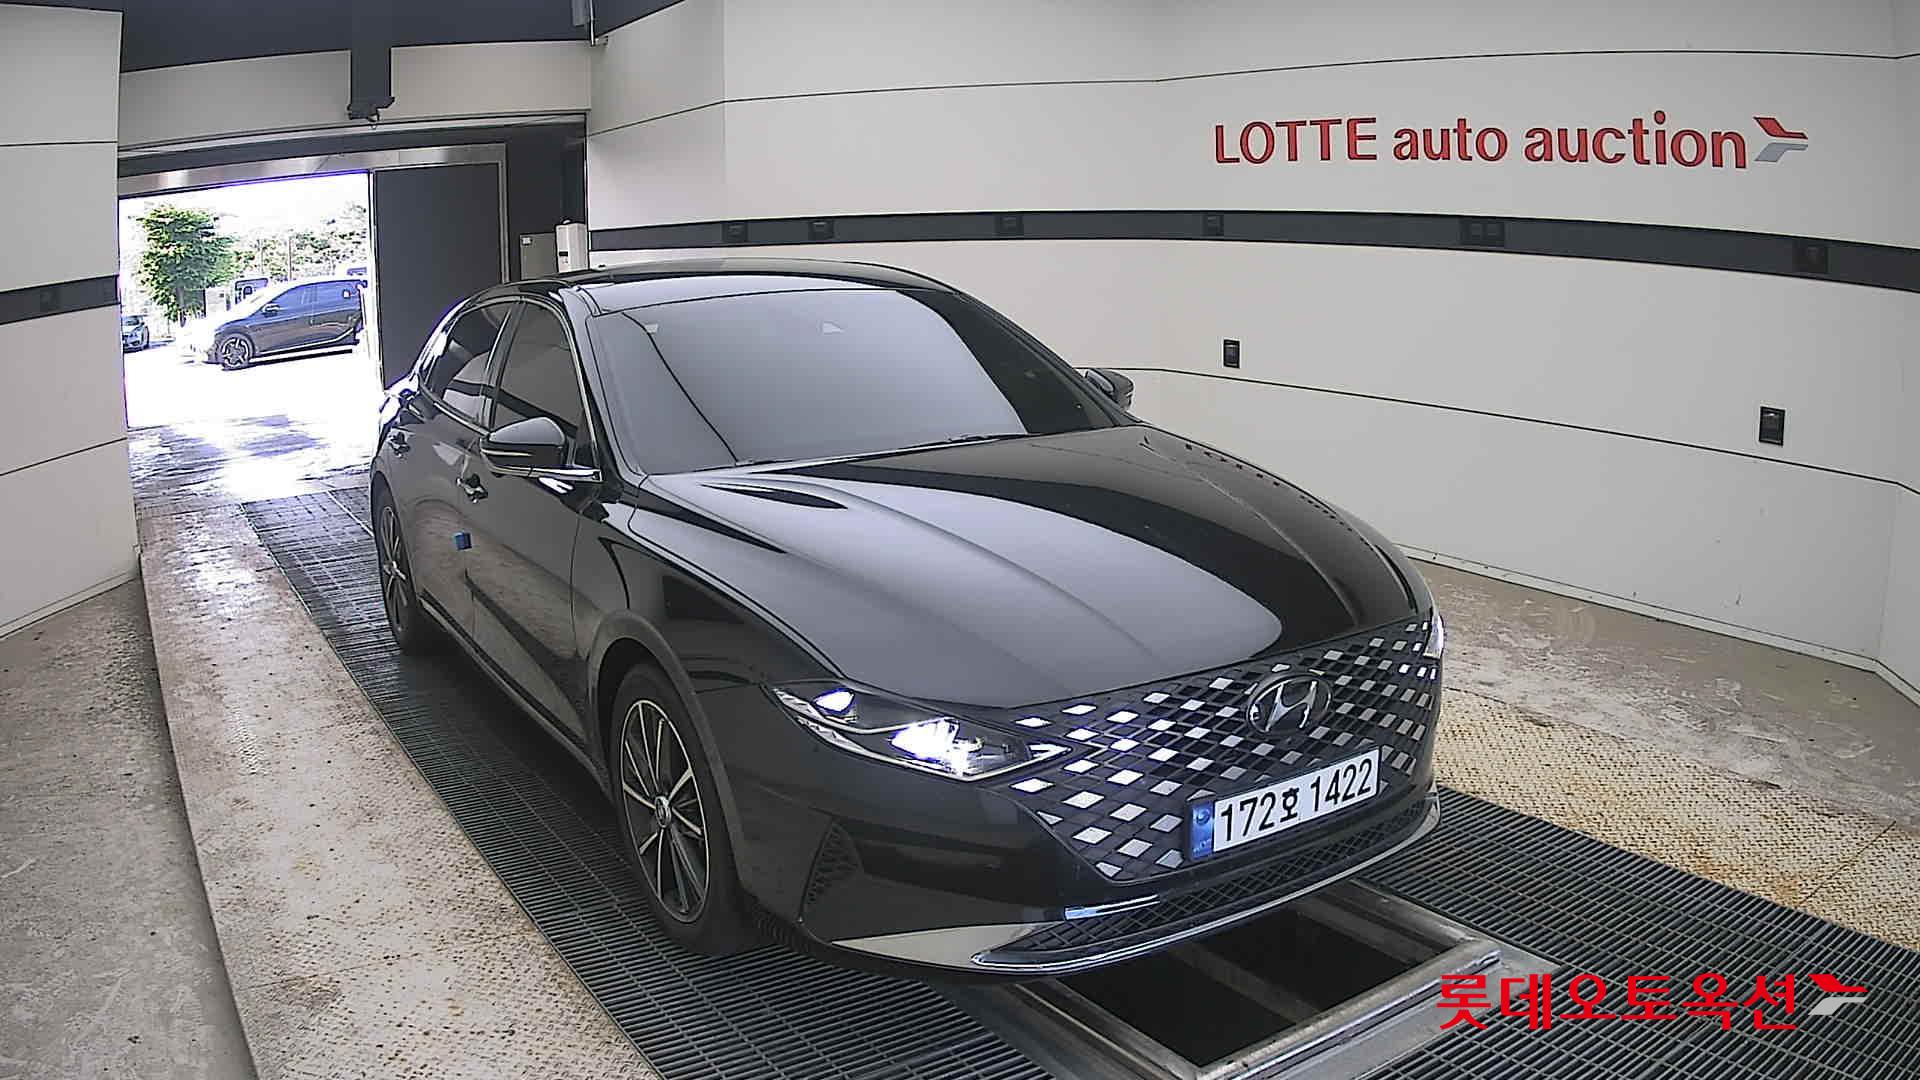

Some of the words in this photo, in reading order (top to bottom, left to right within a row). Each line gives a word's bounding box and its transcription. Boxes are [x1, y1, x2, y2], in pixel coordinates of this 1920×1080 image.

[1214, 117, 1378, 165] LOTTE
[1393, 118, 1508, 162] auto
[1524, 110, 1748, 169] auction
[1221, 787, 1299, 841] 172호
[1311, 758, 1372, 812] 1422
